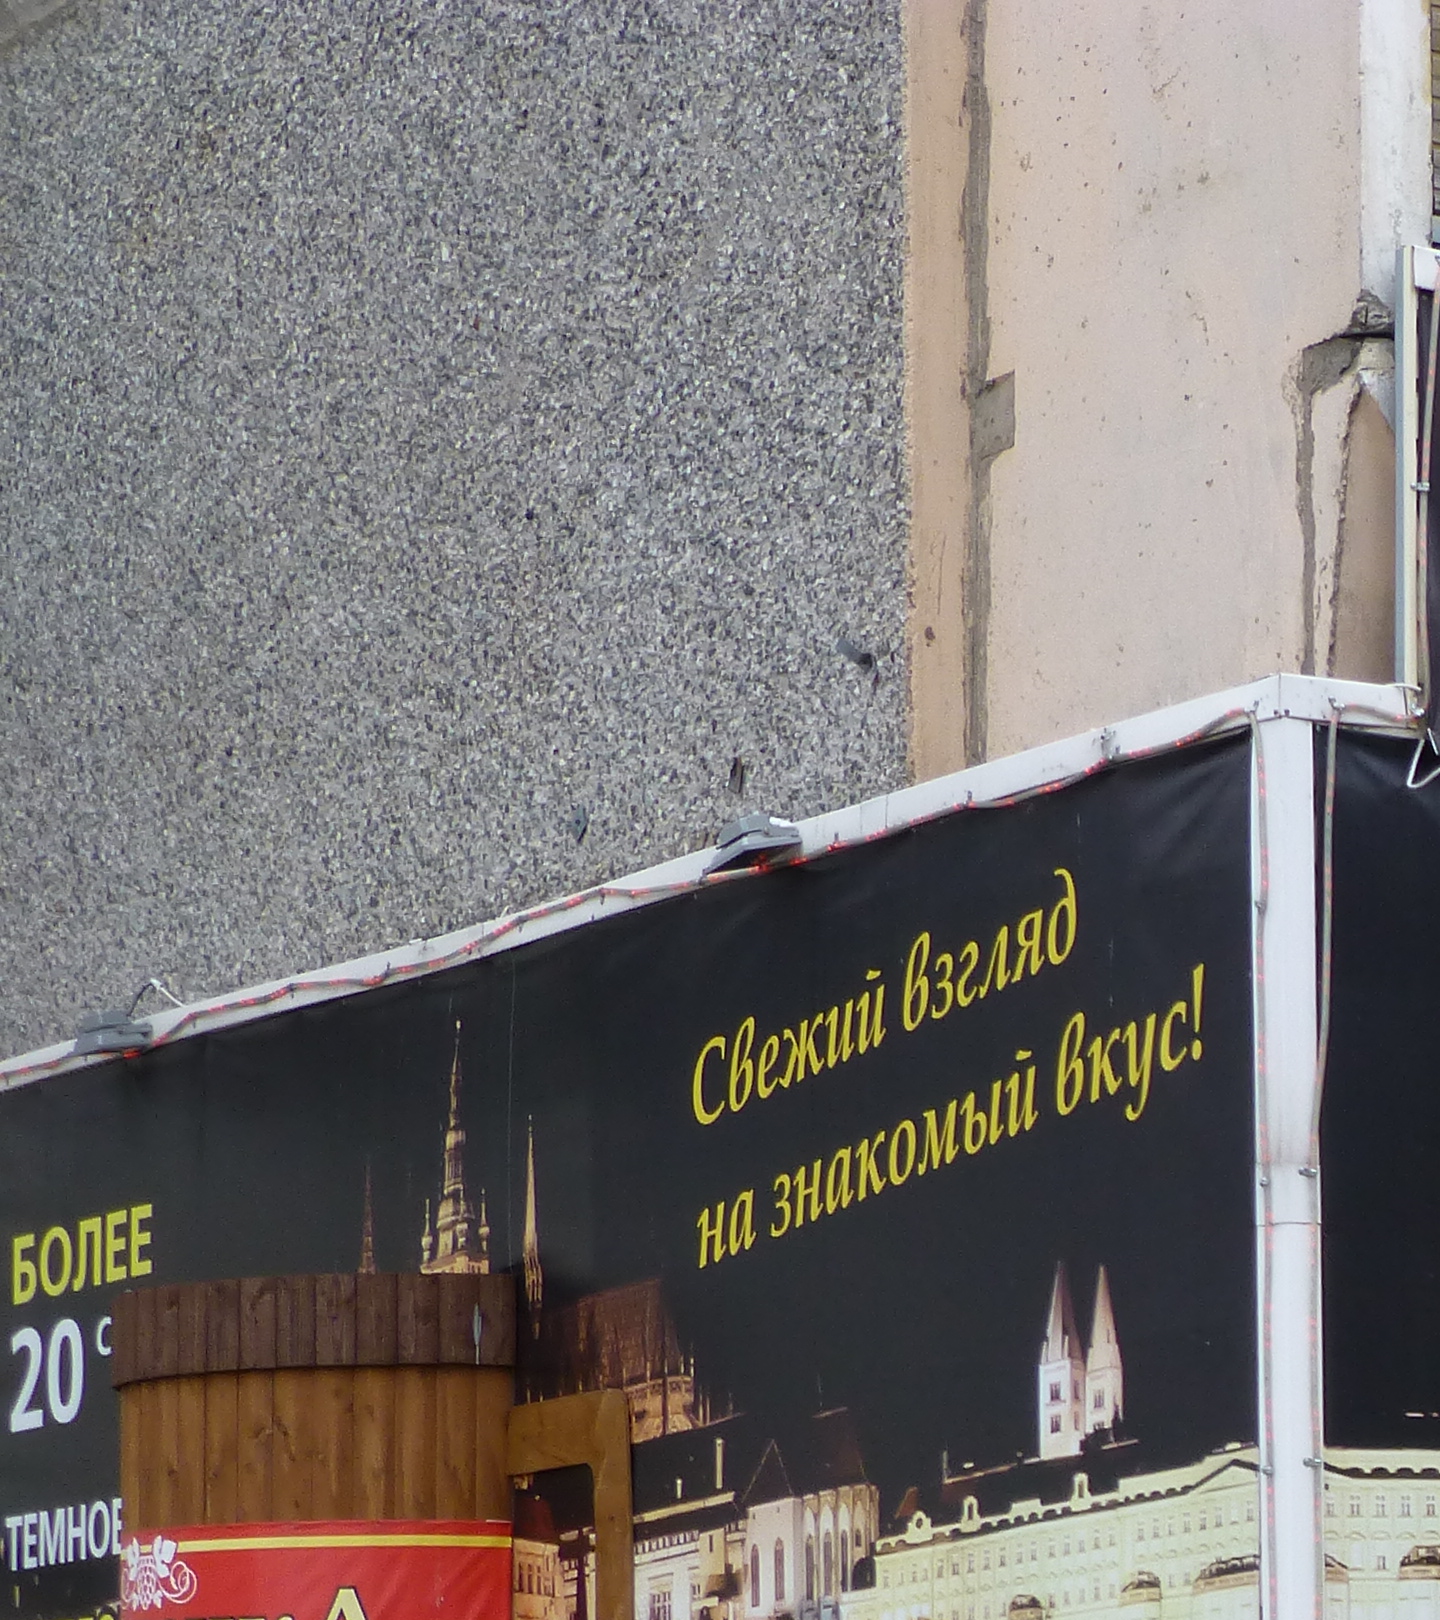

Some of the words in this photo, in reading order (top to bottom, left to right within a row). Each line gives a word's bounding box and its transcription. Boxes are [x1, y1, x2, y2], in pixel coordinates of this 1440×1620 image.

[692, 969, 886, 1125] Свежий
[903, 868, 1079, 1032] взгляд
[697, 1188, 757, 1269] на
[770, 1050, 1040, 1239] знакомый
[1055, 963, 1204, 1121] вкус!
[12, 1204, 152, 1304] БОЛЕЕ
[10, 1318, 84, 1433] 20
[6, 1498, 122, 1571] ТЕМНОЕ
